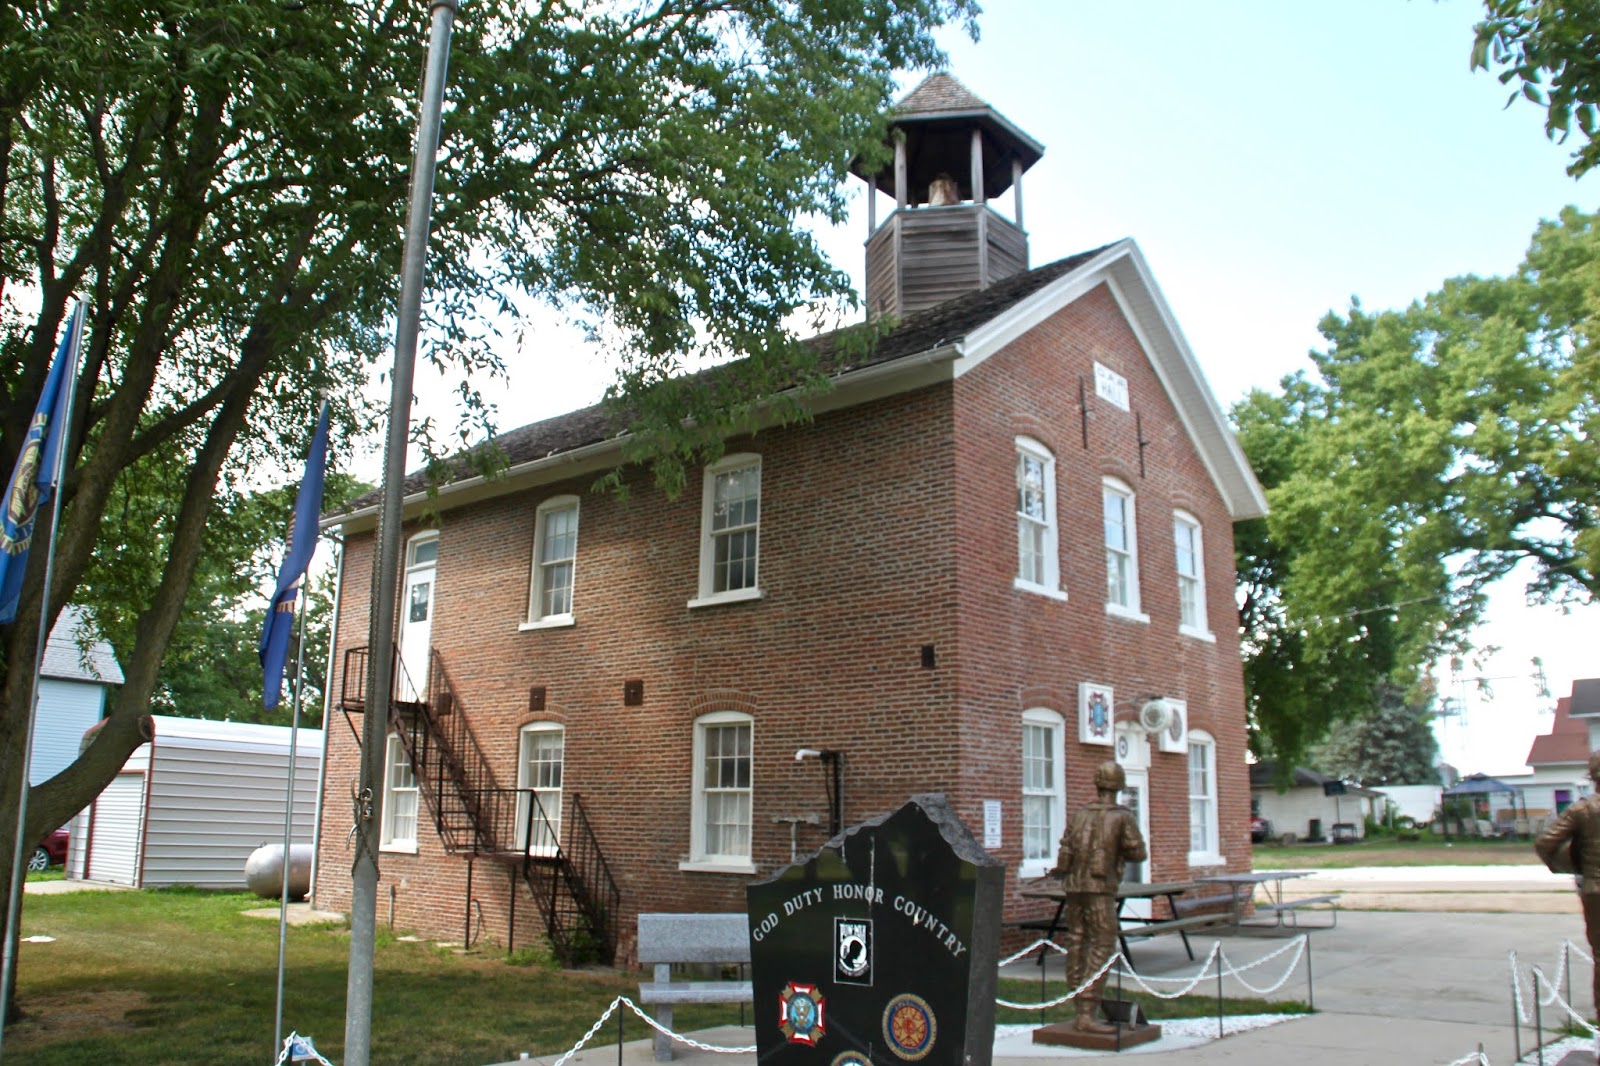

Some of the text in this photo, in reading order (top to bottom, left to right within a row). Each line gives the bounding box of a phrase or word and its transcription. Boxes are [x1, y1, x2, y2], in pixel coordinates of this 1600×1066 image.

[752, 912, 779, 942] GOD
[783, 887, 823, 917] DUTY
[832, 883, 884, 905] HONOR
[893, 895, 967, 958] COUNTRY
